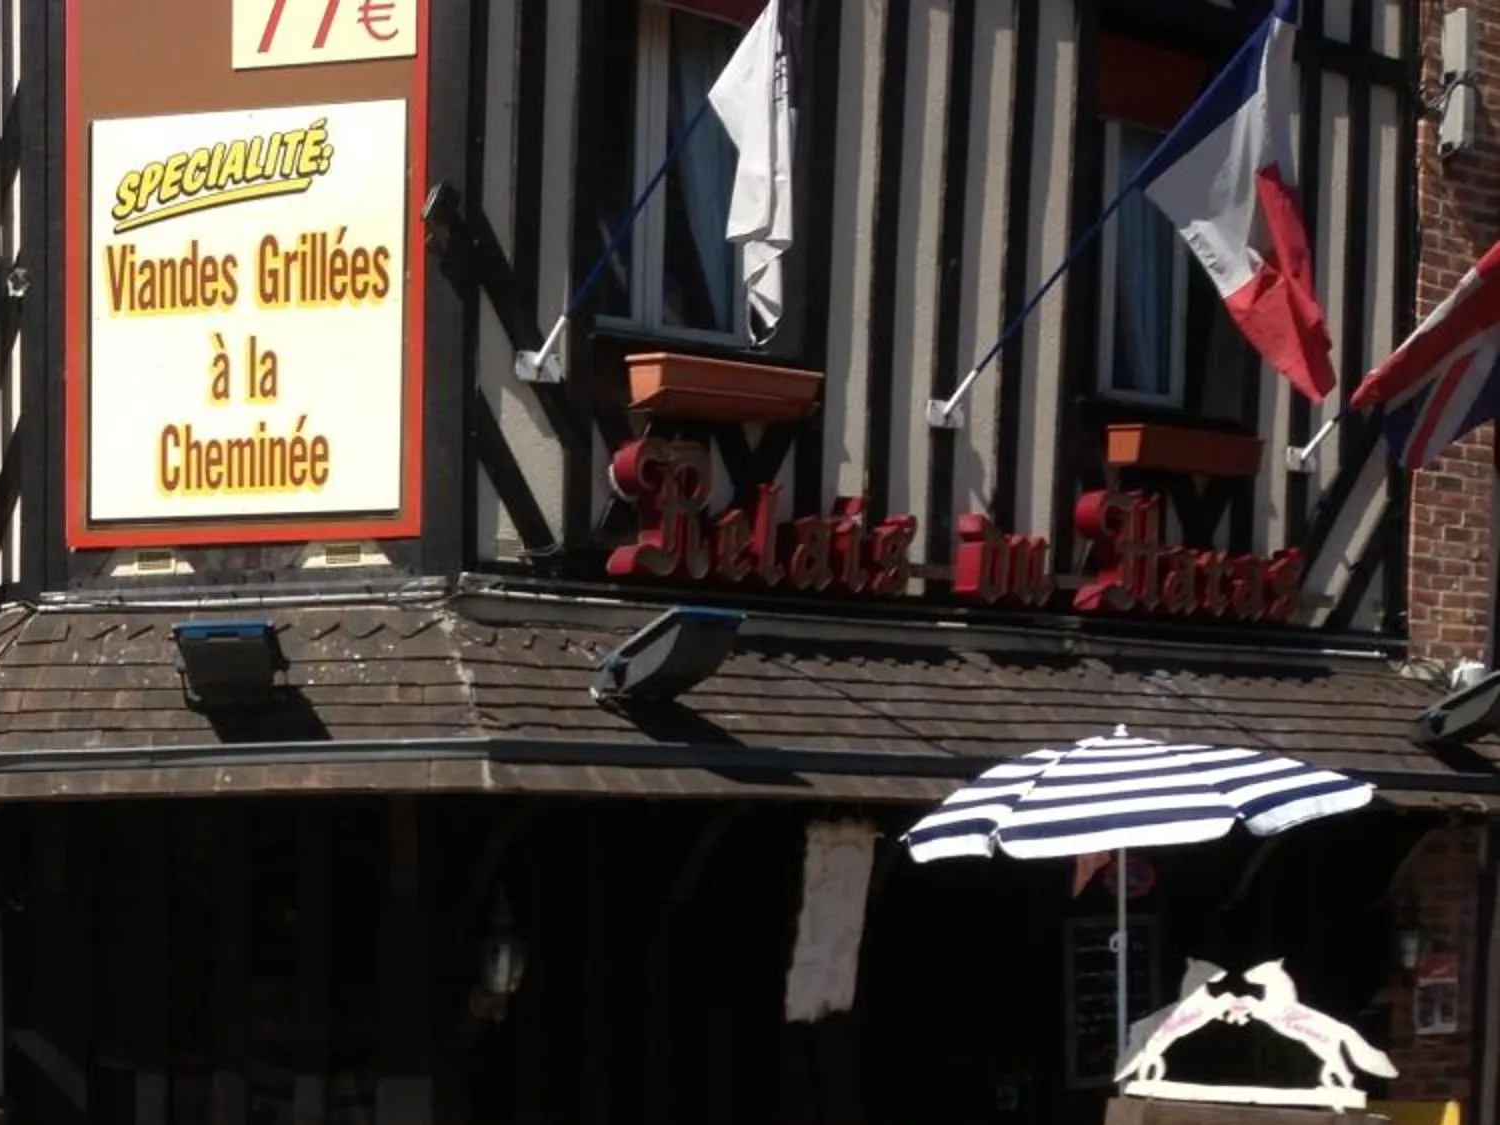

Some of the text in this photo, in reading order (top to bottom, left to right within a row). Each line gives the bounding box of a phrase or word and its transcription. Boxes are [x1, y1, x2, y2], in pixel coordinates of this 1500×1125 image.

[106, 226, 390, 312] Viandes Grillées
[211, 333, 278, 400] à la
[160, 414, 329, 492] Cheminée
[606, 436, 917, 592] Relais
